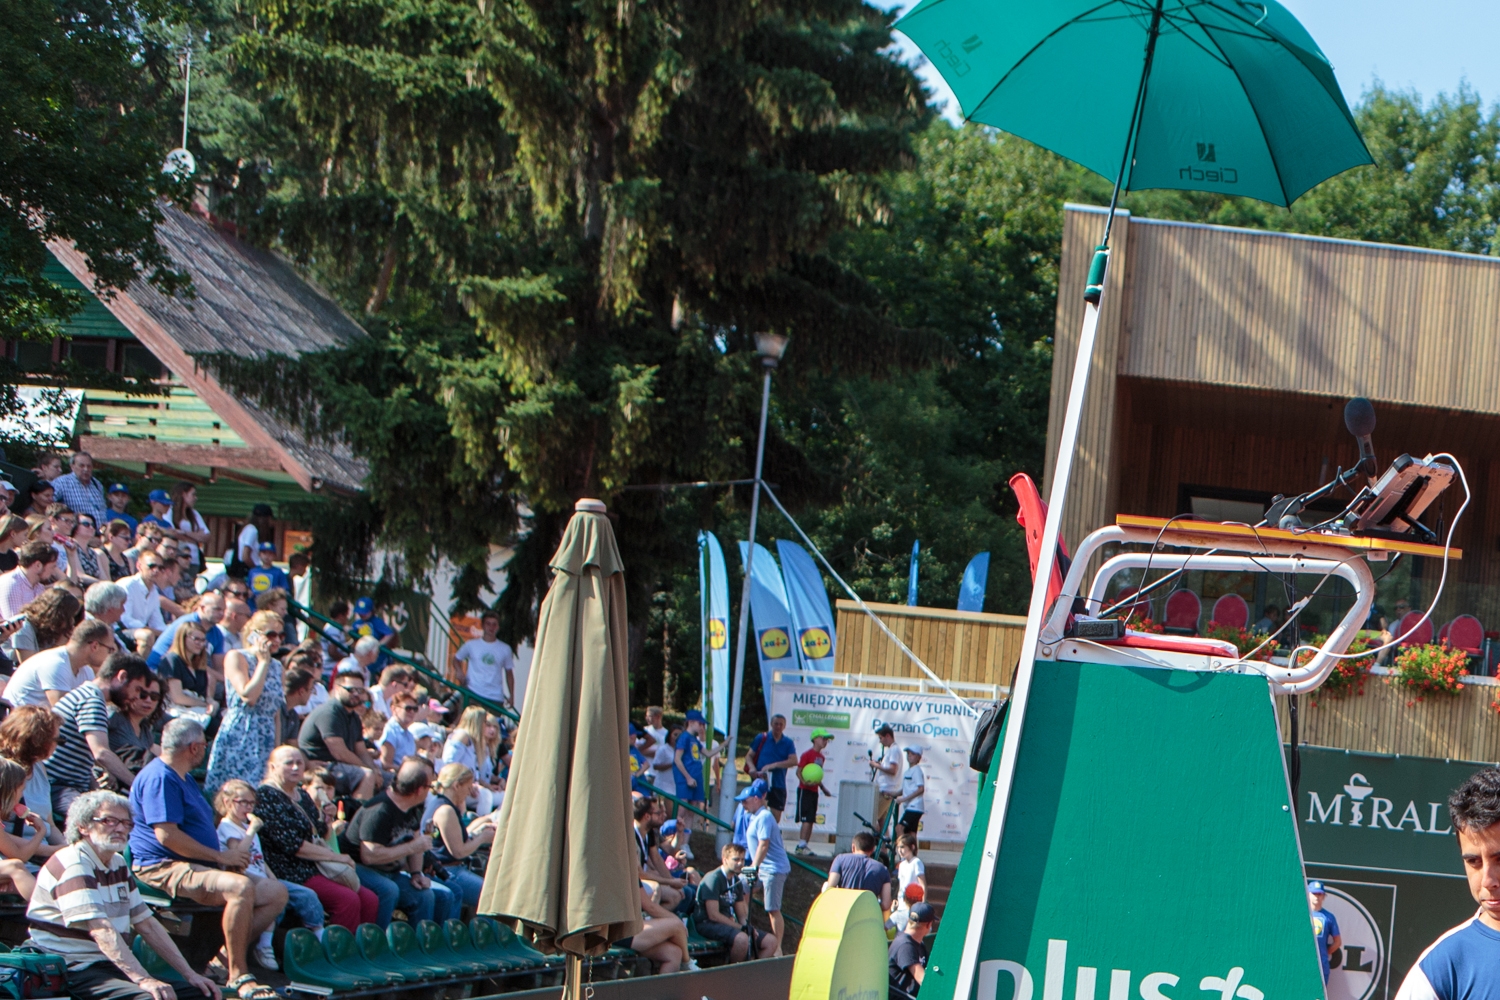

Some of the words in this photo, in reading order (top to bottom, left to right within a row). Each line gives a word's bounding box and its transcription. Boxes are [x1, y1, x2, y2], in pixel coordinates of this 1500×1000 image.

[793, 693, 922, 713] MIĘDZYNARODOWY
[922, 722, 958, 738] Open
[1305, 790, 1456, 835] MIRAL
